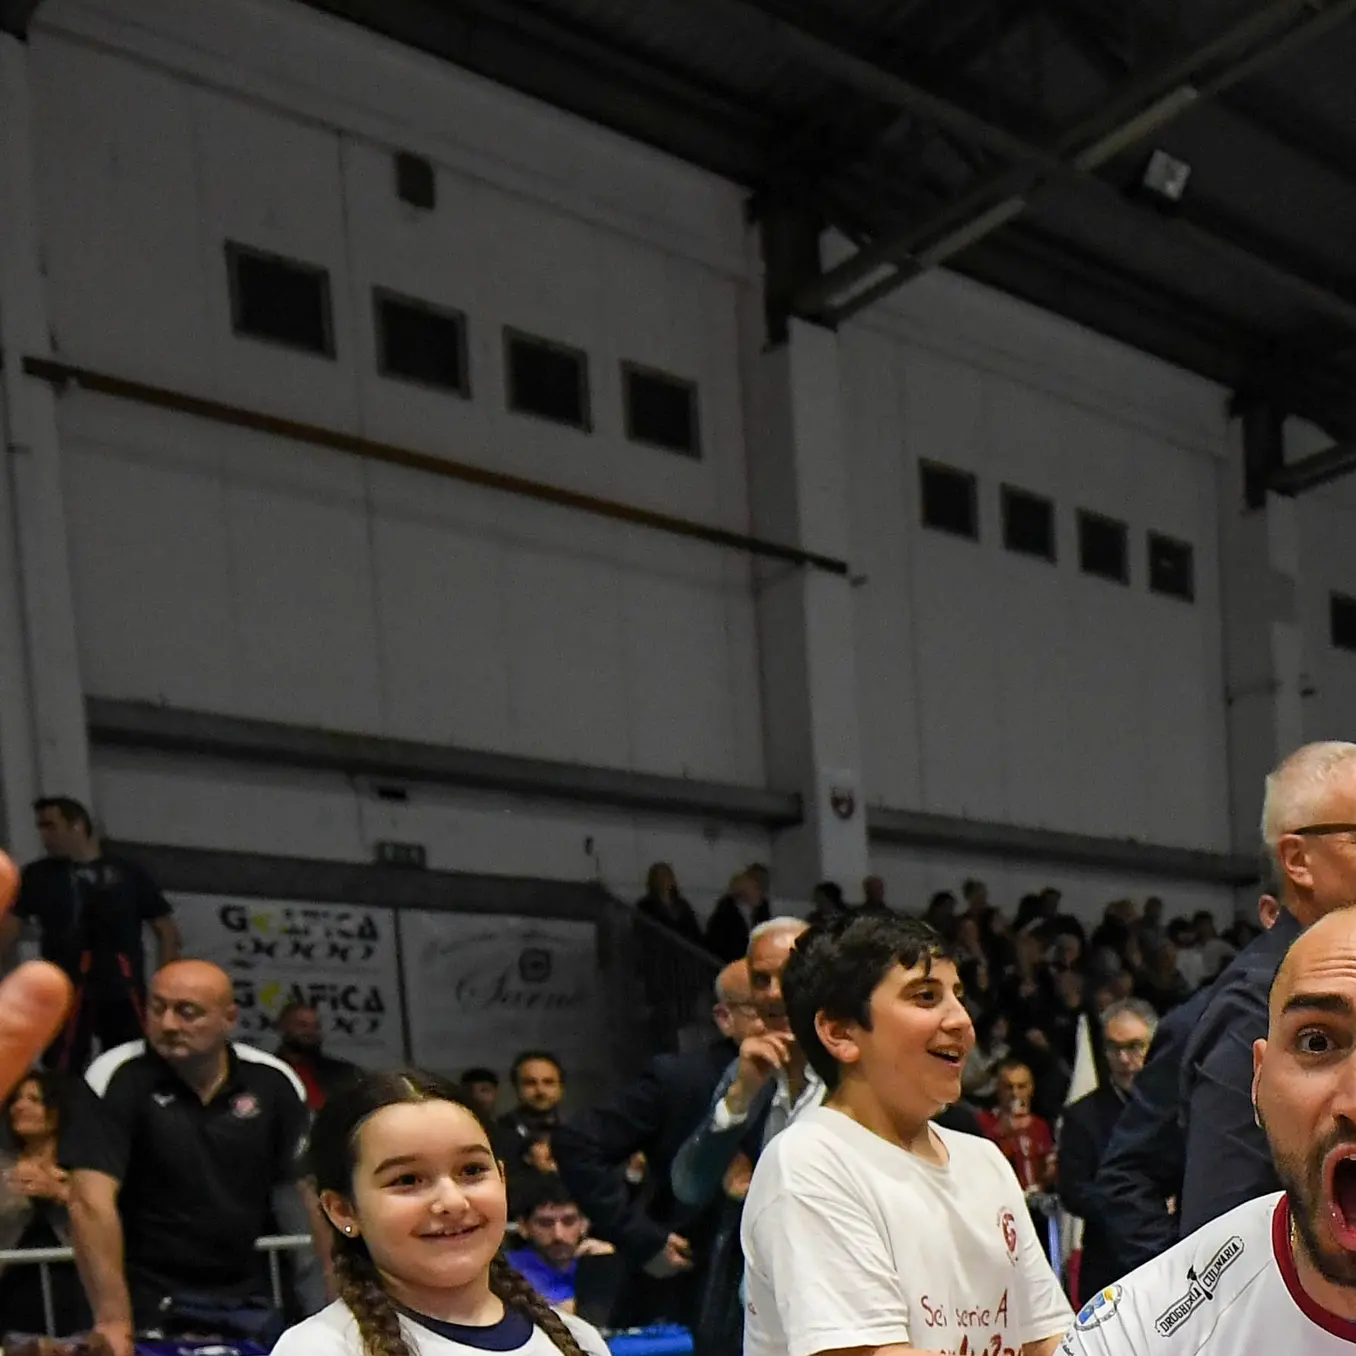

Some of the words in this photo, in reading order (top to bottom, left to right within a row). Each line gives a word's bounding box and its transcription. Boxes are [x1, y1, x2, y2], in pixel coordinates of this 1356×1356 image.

[1202, 1242, 1240, 1288] CULINARIA
[920, 1295, 947, 1328] Sei
[1159, 1286, 1202, 1334] DROGHERIA
